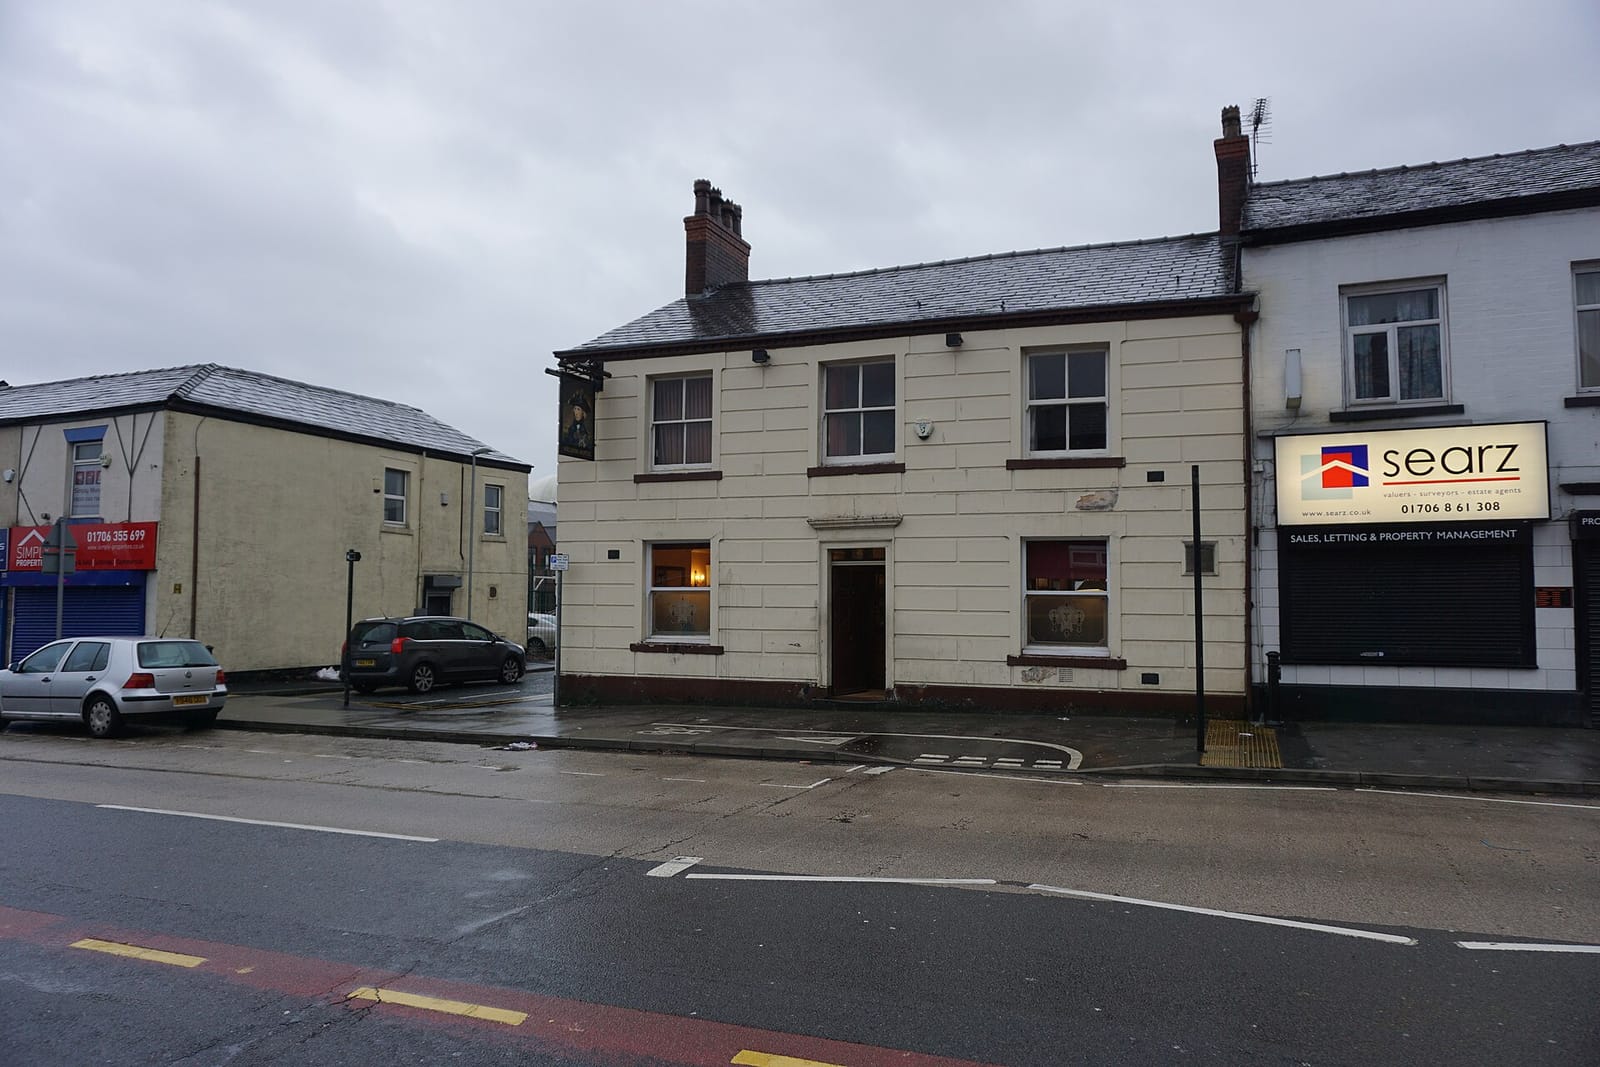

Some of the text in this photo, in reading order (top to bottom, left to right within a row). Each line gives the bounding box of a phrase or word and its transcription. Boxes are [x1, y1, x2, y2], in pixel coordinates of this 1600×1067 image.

[1383, 444, 1520, 477] searz
[1383, 491, 1411, 499] valuers
[1419, 489, 1458, 498] surveyors
[1467, 488, 1492, 496] estate
[1495, 487, 1521, 496] agents
[1302, 509, 1371, 517] www.searz.co.uk
[1401, 504, 1440, 514] 01706
[1477, 502, 1500, 511] 308
[87, 529, 145, 542] 01706 355 699
[1290, 530, 1518, 544] SALES, LETTING & PROPERTY MANAGEMENT
[16, 546, 49, 559] SIMPL
[16, 559, 43, 567] PROPERTI
